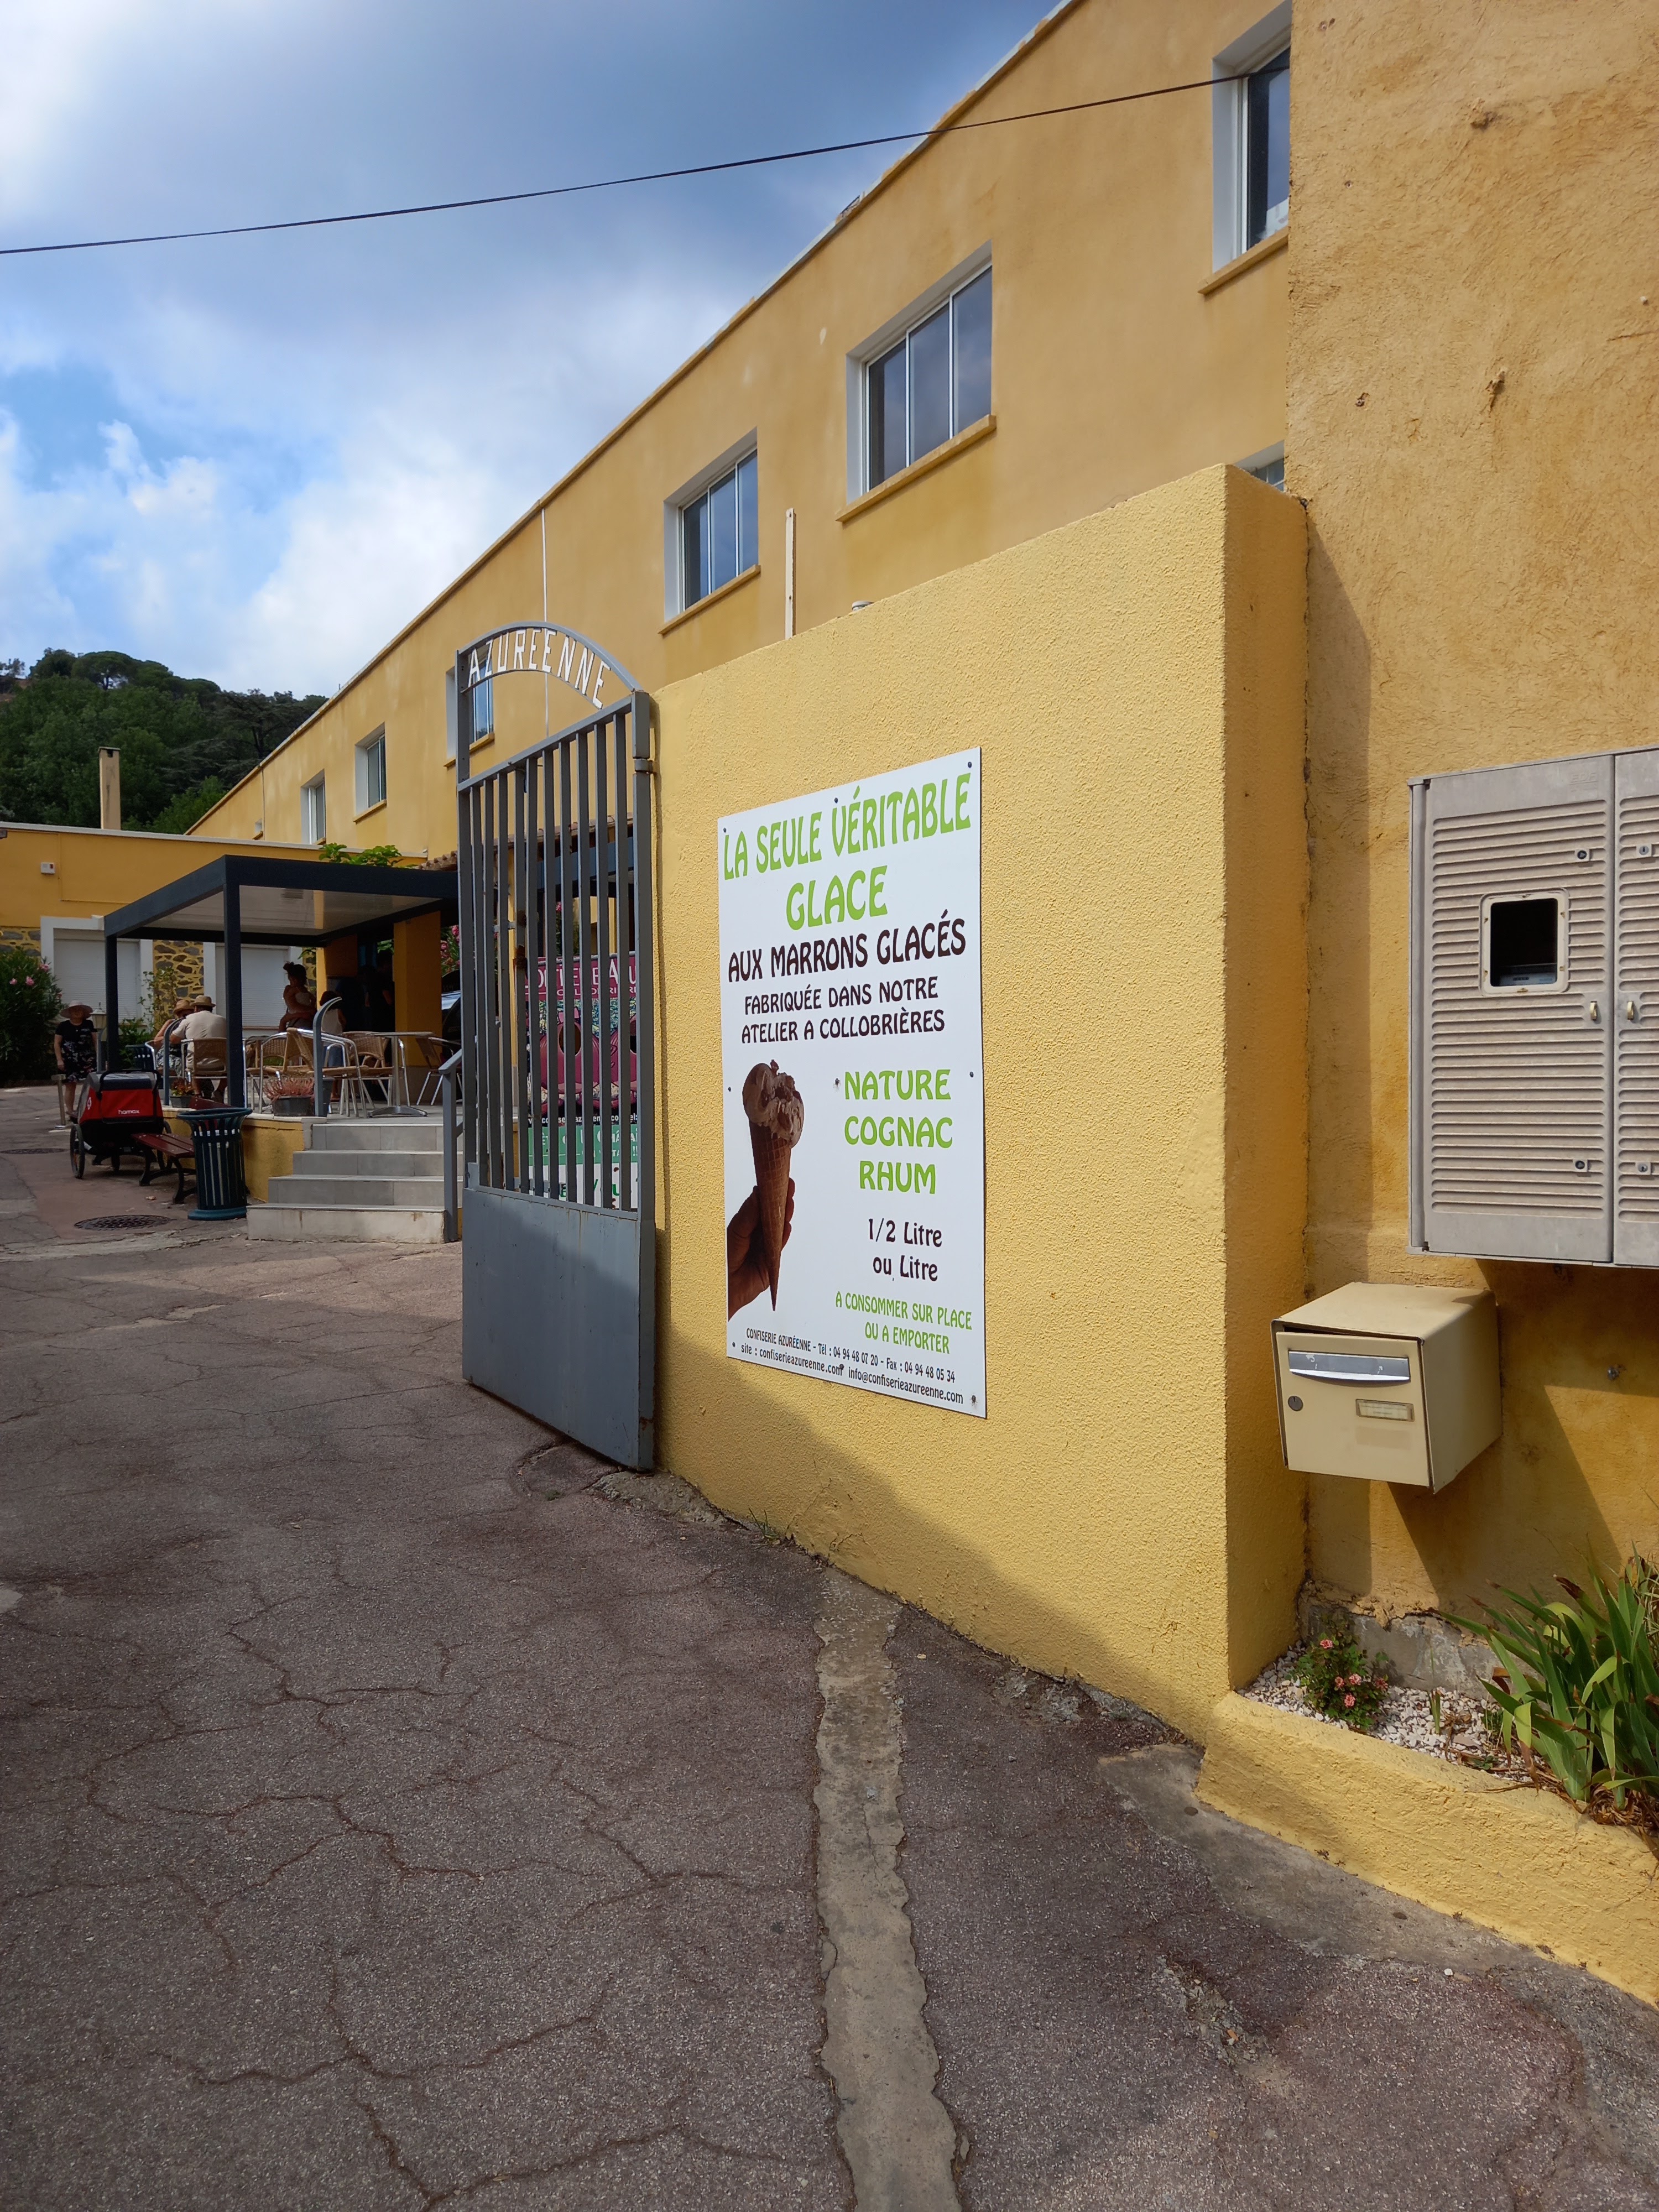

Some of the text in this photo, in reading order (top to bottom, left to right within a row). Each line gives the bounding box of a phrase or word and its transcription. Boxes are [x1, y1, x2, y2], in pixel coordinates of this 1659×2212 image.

[468, 628, 611, 709] AZUREENNE
[724, 773, 971, 880] LA SEULE VÉRITABLE
[786, 865, 888, 930] GLACE
[728, 909, 966, 982] AUX MARRONS GLACÉS
[745, 976, 938, 1015] FABRIQUÉE DANS NOTRE
[742, 1006, 945, 1044] ATELIER A COLLOBRIÈRES
[845, 1070, 951, 1100] NATURE
[845, 1116, 952, 1148] COGNAC
[860, 1161, 936, 1194] RHUM
[869, 1218, 942, 1247] 1/2 Litre
[873, 1255, 937, 1281] ou Litre
[836, 1291, 972, 1330] A CONSOMMER SUR PLACE
[747, 1328, 776, 1344] CONFISERIE
[779, 1335, 811, 1352] AZURÉENNE
[833, 1347, 841, 1358] 04
[843, 1348, 849, 1360] 94
[852, 1350, 859, 1362] 48
[862, 1352, 868, 1364] 07
[871, 1354, 878, 1366] 20
[887, 1358, 897, 1370] Fax
[905, 1361, 912, 1374] 04
[915, 1364, 923, 1376] 94
[926, 1366, 933, 1379] 48
[936, 1368, 944, 1380] 05
[947, 1370, 955, 1383] 34
[865, 1322, 950, 1354] OU A EMPORTER
[742, 1343, 752, 1354] site
[760, 1349, 842, 1376] confiserieazureenne.com
[849, 1366, 963, 1404] info@confiserieazureenne.com
